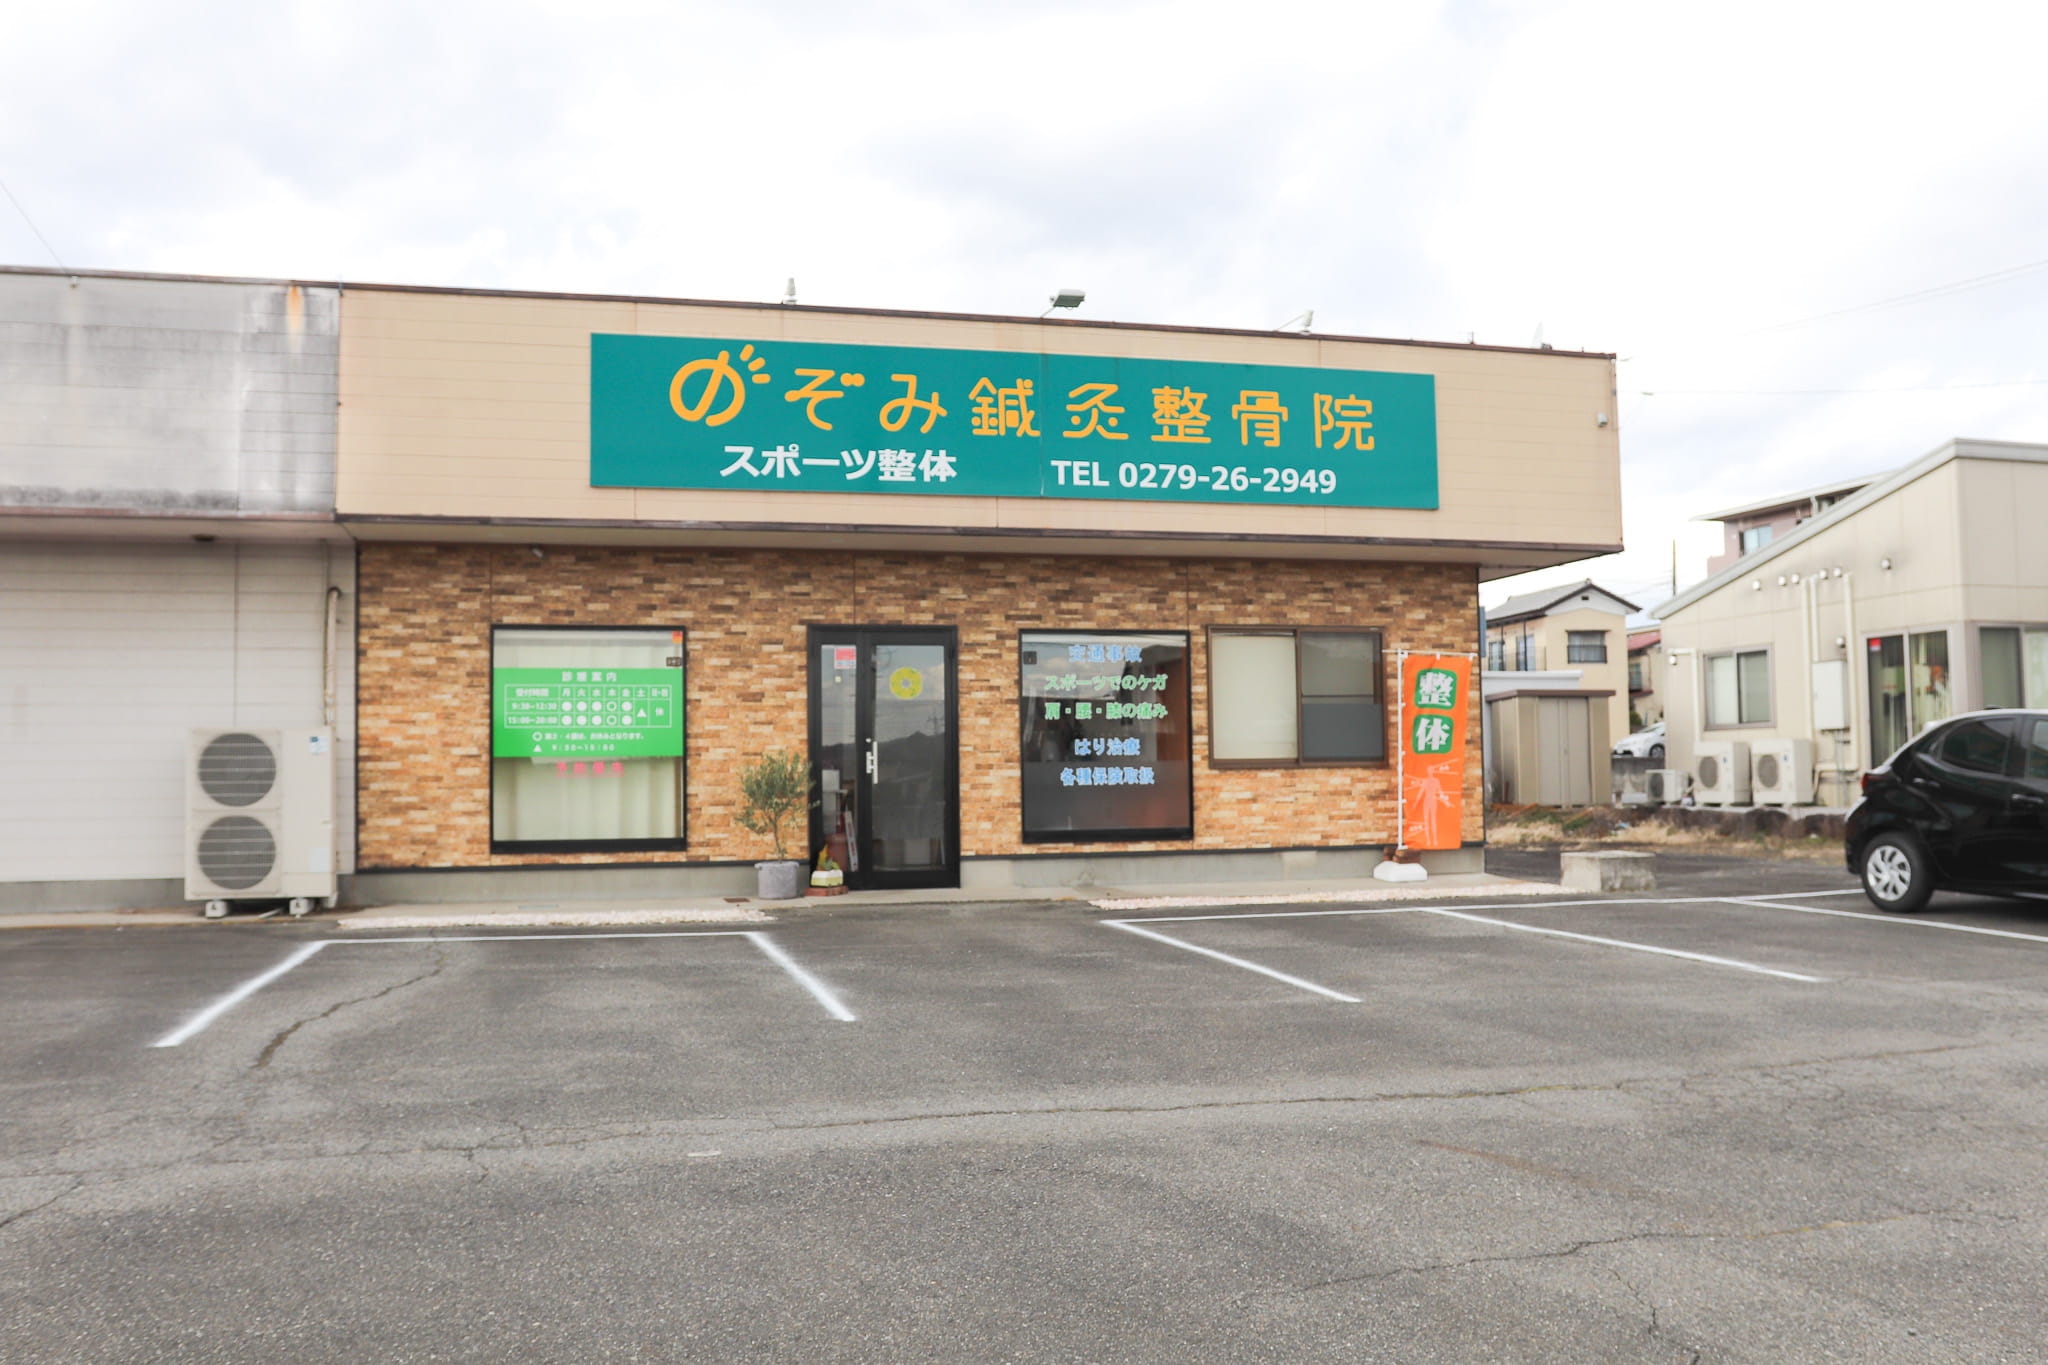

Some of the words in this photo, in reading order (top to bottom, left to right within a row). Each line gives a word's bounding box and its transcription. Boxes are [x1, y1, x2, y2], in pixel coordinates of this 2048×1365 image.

[669, 343, 1376, 453] のぞみ鍼灸整骨院
[719, 443, 958, 484] スポーツ整体
[1051, 460, 1110, 490] TEL
[1118, 462, 1338, 495] 0279-26-2949
[1068, 644, 1143, 663] 交通事故
[1044, 673, 1168, 691] スポーツでのケガ
[1415, 671, 1453, 751] 整体
[1074, 737, 1141, 756] はり治療
[1060, 766, 1155, 786] 各種保険取扱
